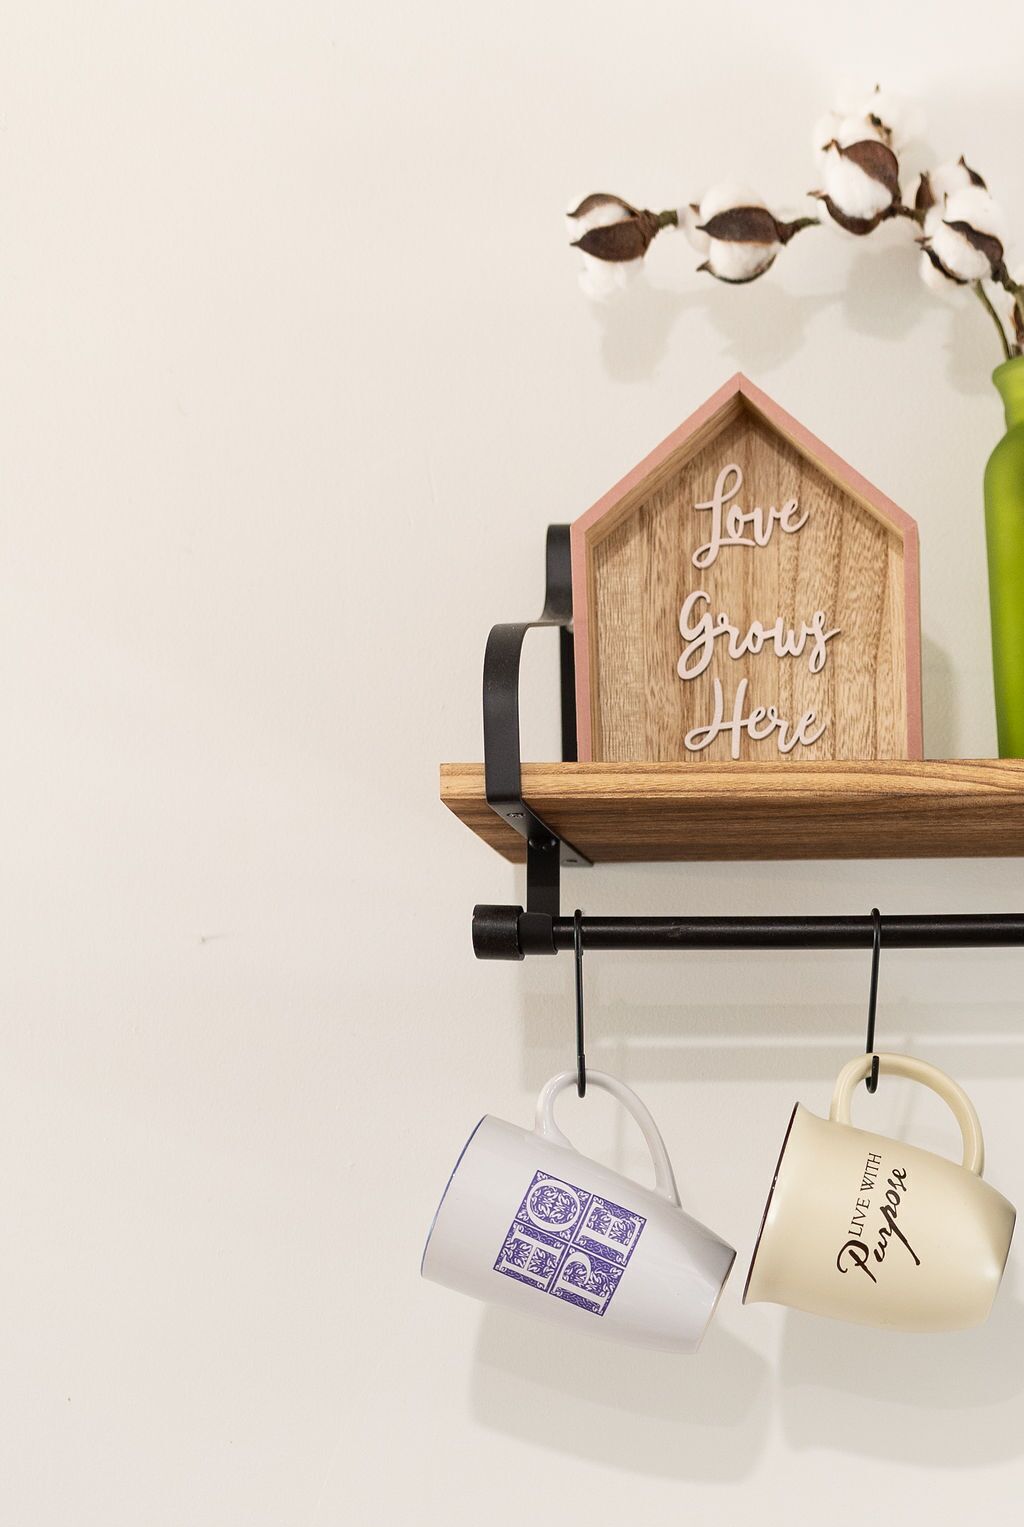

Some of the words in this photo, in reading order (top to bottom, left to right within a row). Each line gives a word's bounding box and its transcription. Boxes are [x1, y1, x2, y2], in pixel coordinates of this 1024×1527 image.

[692, 463, 810, 569] Love
[677, 590, 841, 680] Grows
[684, 678, 826, 760] Here
[836, 1167, 920, 1283] Purpose
[848, 1197, 871, 1238] LIVE
[860, 1152, 882, 1193] WITH
